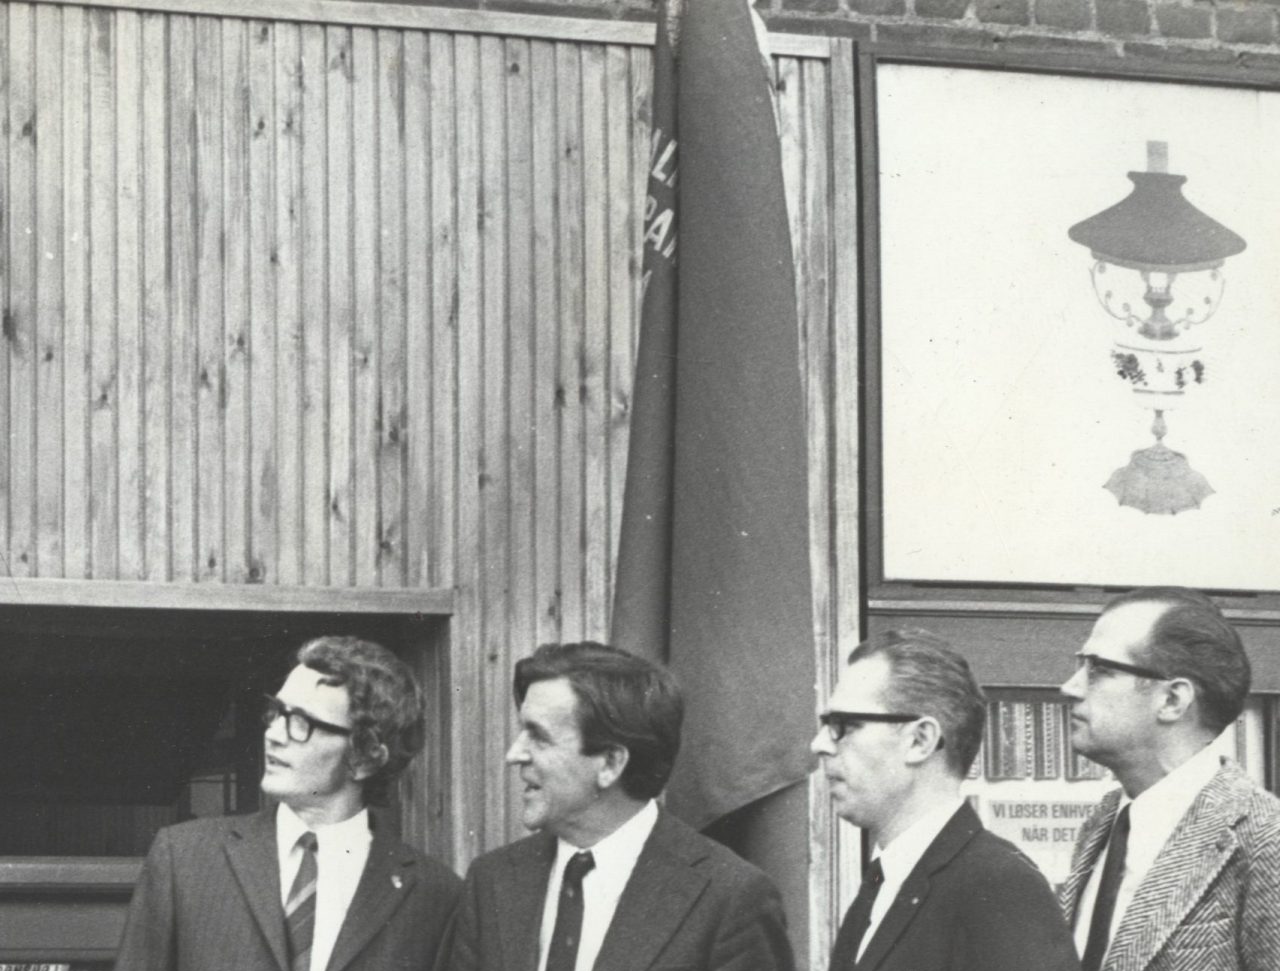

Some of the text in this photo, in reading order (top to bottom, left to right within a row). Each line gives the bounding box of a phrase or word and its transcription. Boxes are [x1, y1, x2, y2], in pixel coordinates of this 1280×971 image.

[992, 803, 1100, 819] VI LØSER ENHVE
[1022, 825, 1048, 842] NÅR
